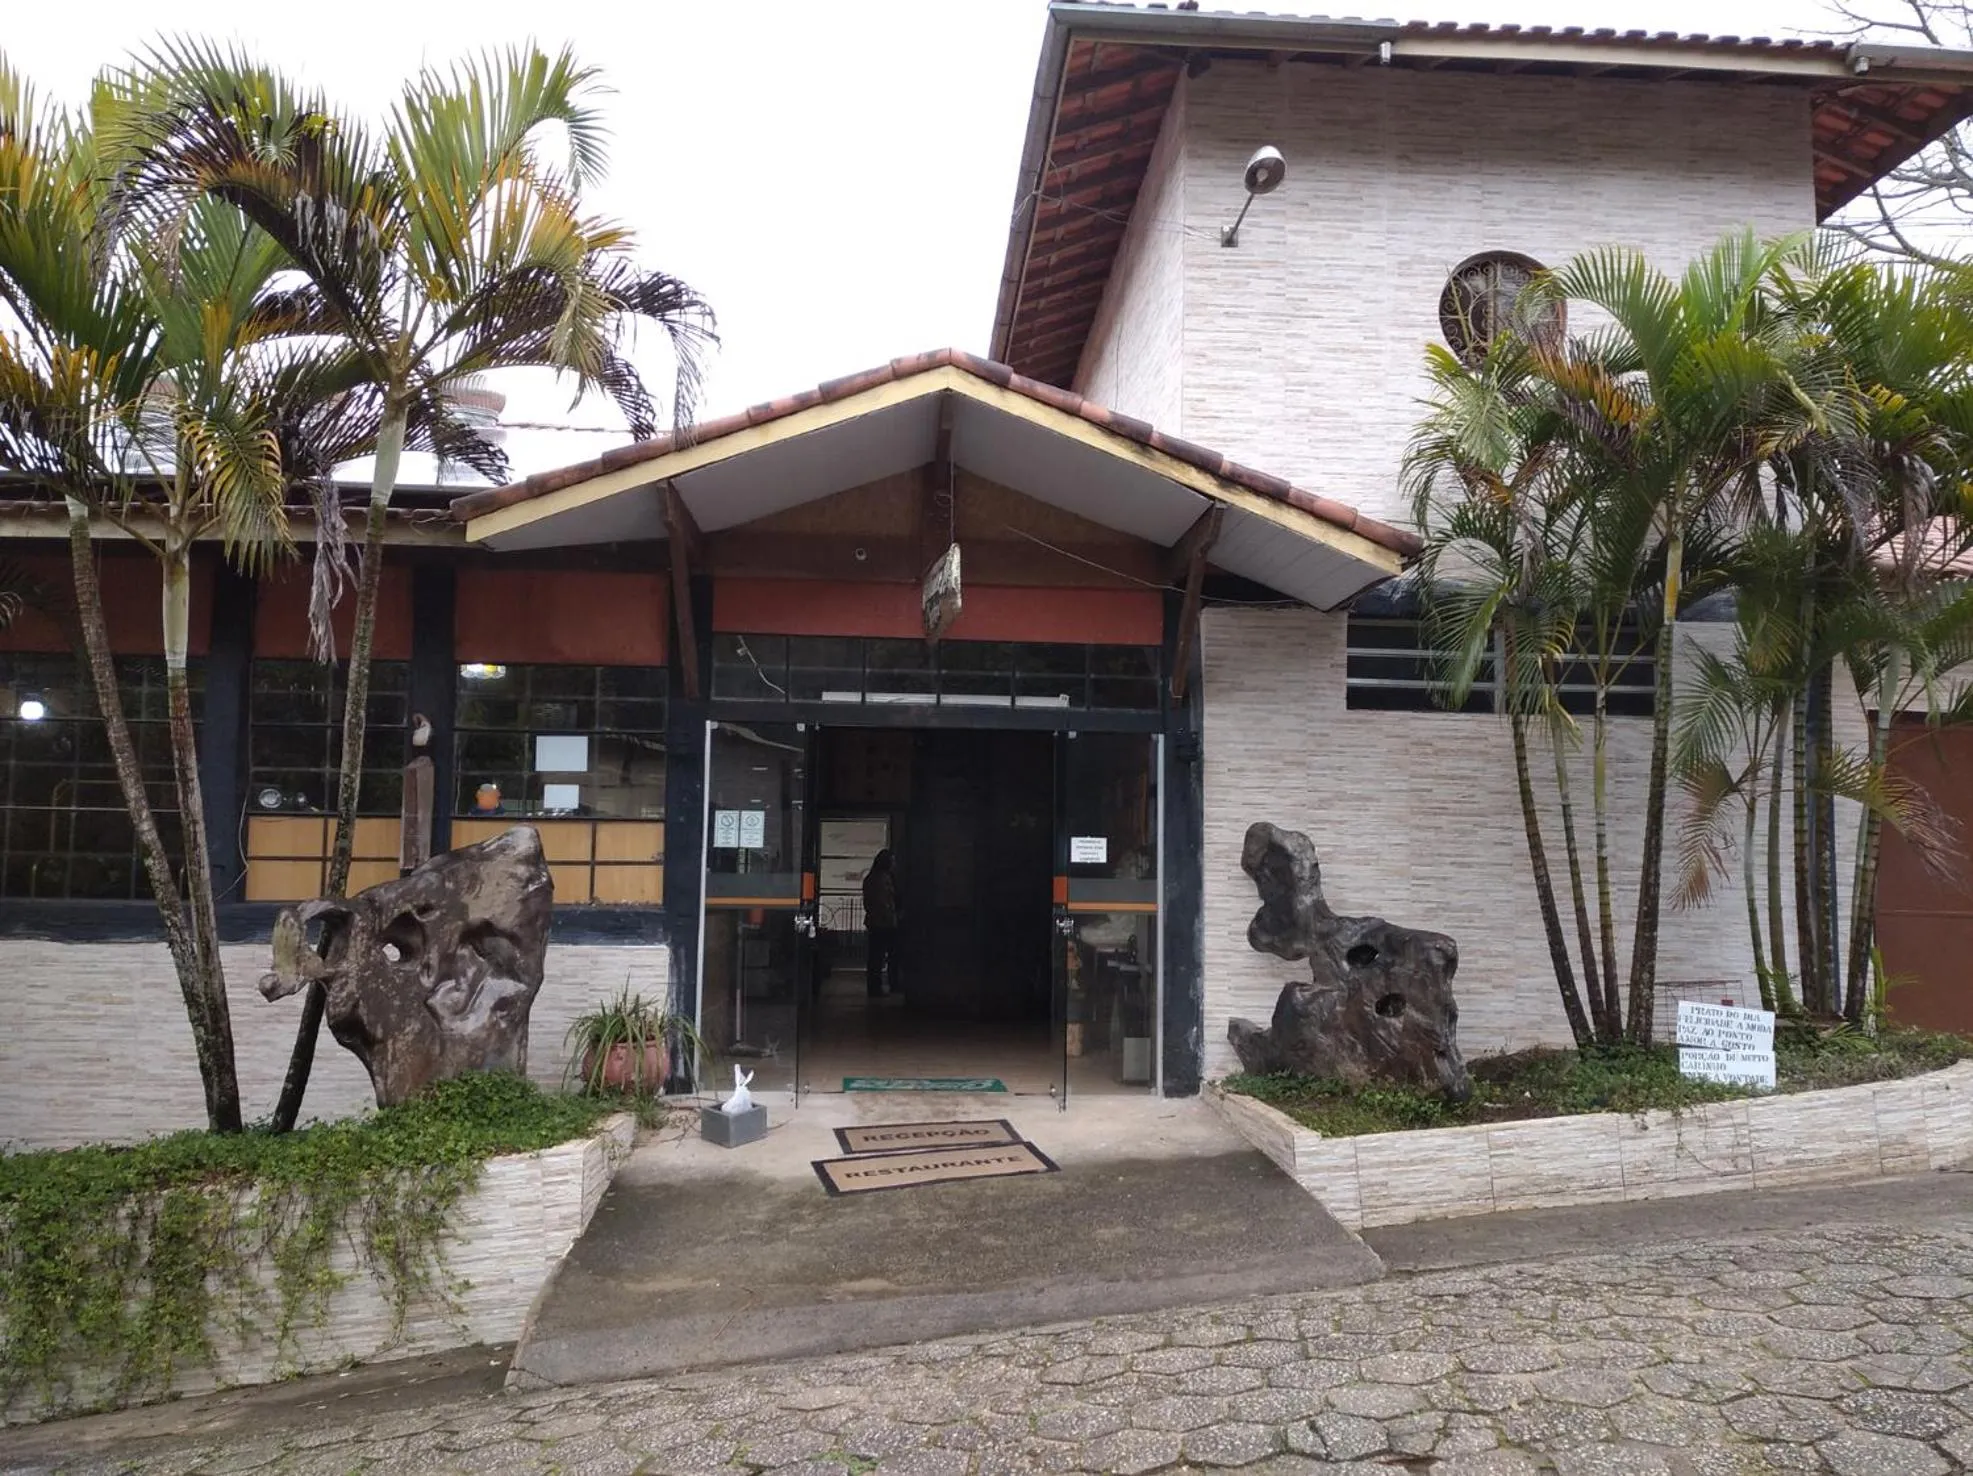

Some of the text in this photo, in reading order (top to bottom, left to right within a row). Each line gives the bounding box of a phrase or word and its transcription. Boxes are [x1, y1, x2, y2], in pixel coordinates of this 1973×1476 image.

[1678, 1025, 1753, 1041] PAZ AO PONTO
[1721, 1040, 1756, 1051] GOSTO
[1681, 1061, 1727, 1071] CARINHO
[862, 1127, 991, 1143] RECEPÇÃO
[844, 1155, 1024, 1180] RESTAURANTE
